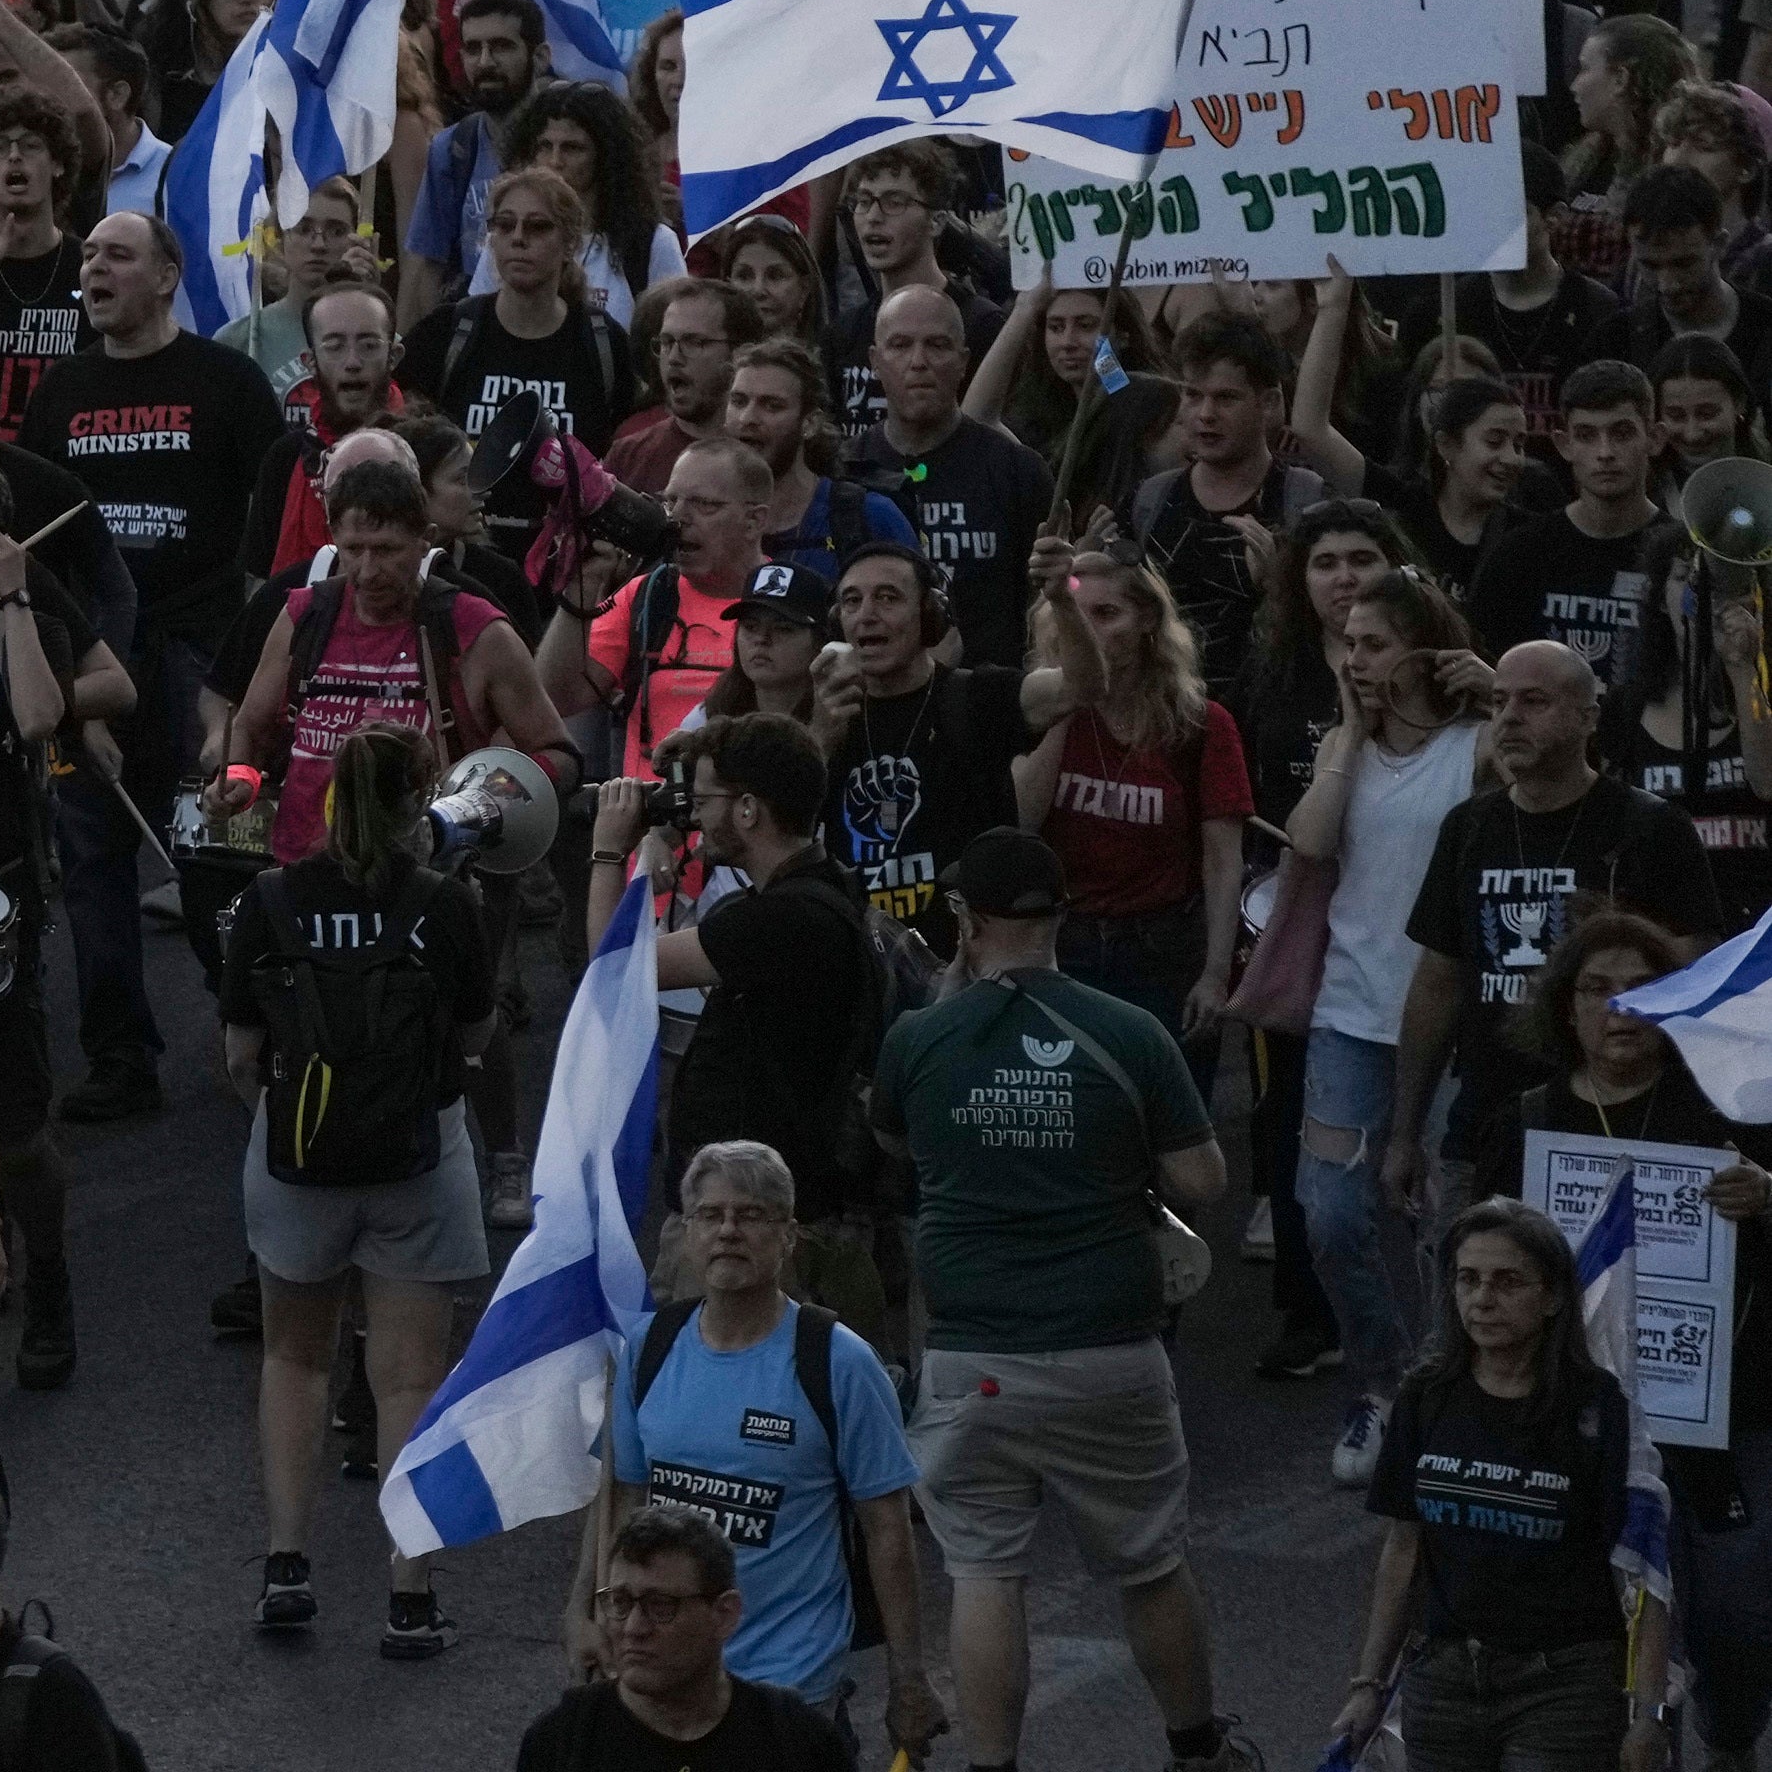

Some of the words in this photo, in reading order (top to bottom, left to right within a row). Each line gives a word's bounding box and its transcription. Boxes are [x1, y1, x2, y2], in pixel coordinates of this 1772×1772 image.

[1366, 82, 1502, 146] אולי
[1221, 162, 1447, 239] הגליל
[19, 308, 80, 331] מחזירים
[36, 331, 77, 356] אותם
[68, 403, 193, 439] CRIME
[67, 431, 191, 458] MINISTER
[96, 501, 143, 519] מתאב
[145, 504, 188, 523] ישראל
[1543, 592, 1639, 628] בחירות
[1479, 868, 1577, 895] בחירות
[993, 1067, 1073, 1088] התנועה
[968, 1087, 1073, 1106] הרפורמית
[950, 1106, 1018, 1126] הרפורמי
[1023, 1108, 1075, 1127] המרכז
[980, 1127, 1039, 1148] ומדינה
[1045, 1129, 1075, 1149] לדת
[1553, 1197, 1587, 1214] עזה
[746, 1415, 791, 1432] מחאת
[652, 1466, 738, 1499] דמוקרטיה
[742, 1485, 777, 1506] אין
[722, 1510, 766, 1540] אין
